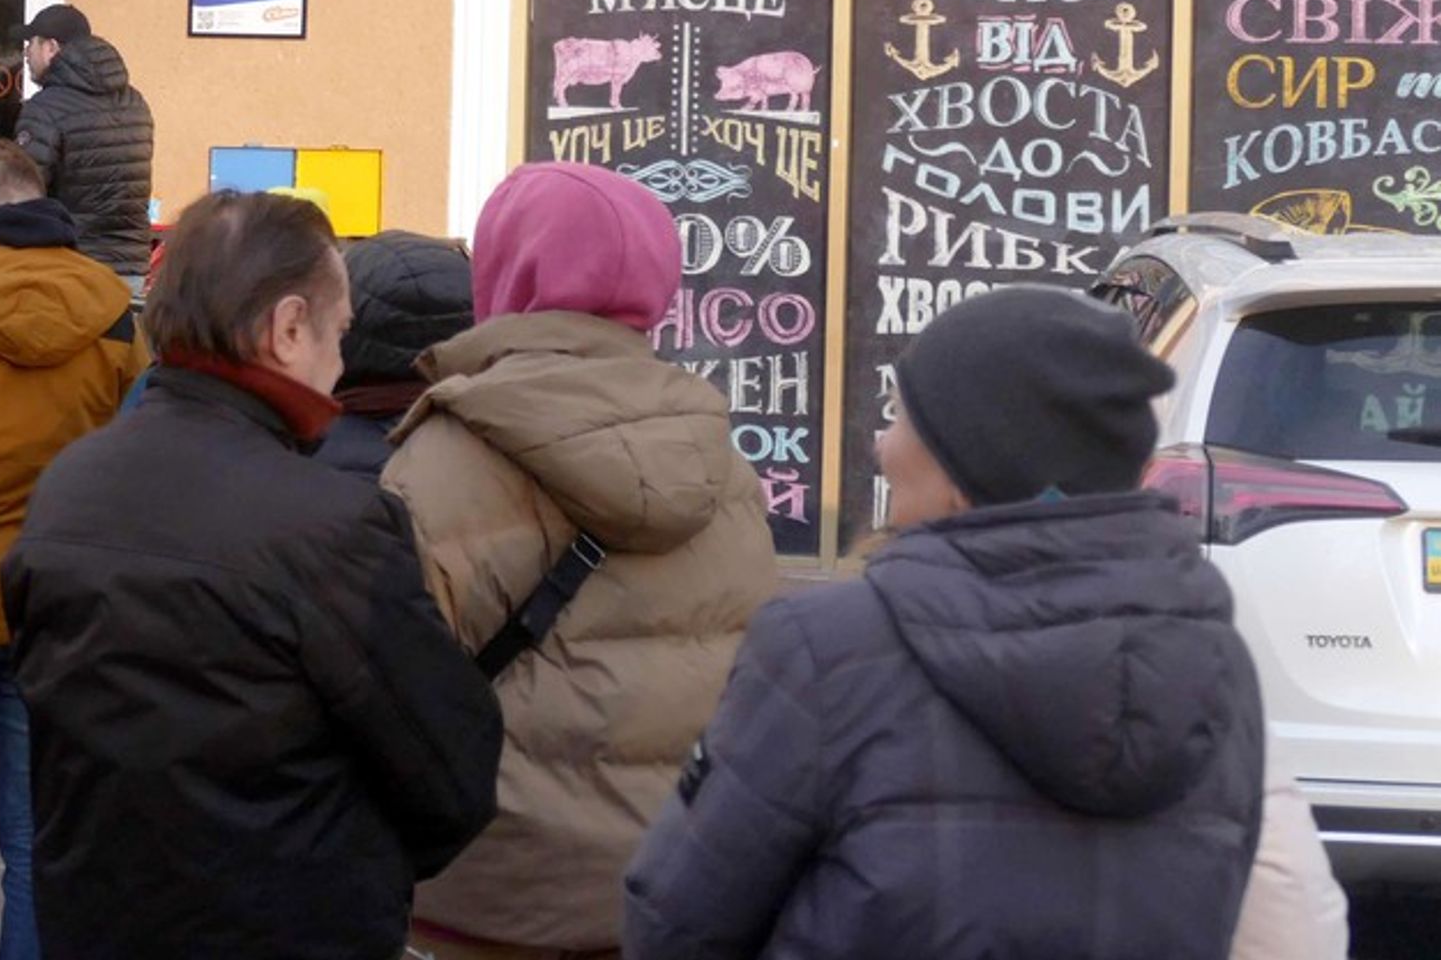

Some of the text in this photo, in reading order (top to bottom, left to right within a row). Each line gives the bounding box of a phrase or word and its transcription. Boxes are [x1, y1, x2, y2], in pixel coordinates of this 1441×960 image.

[975, 15, 1080, 74] ВІД
[1226, 53, 1376, 109] СИР
[622, 115, 667, 152] ЦЕ
[886, 75, 1152, 168] ХВОСТА
[1222, 118, 1441, 190] КОВБАС
[700, 117, 823, 202] ХОЧ ЦЕ
[881, 143, 1151, 235] ГОЛОВИ
[979, 138, 1064, 182] ДО
[672, 213, 812, 278] 0%
[878, 187, 1120, 275] РИБК
[648, 286, 817, 351] ЯСО
[1306, 635, 1373, 650] TOYOTA
